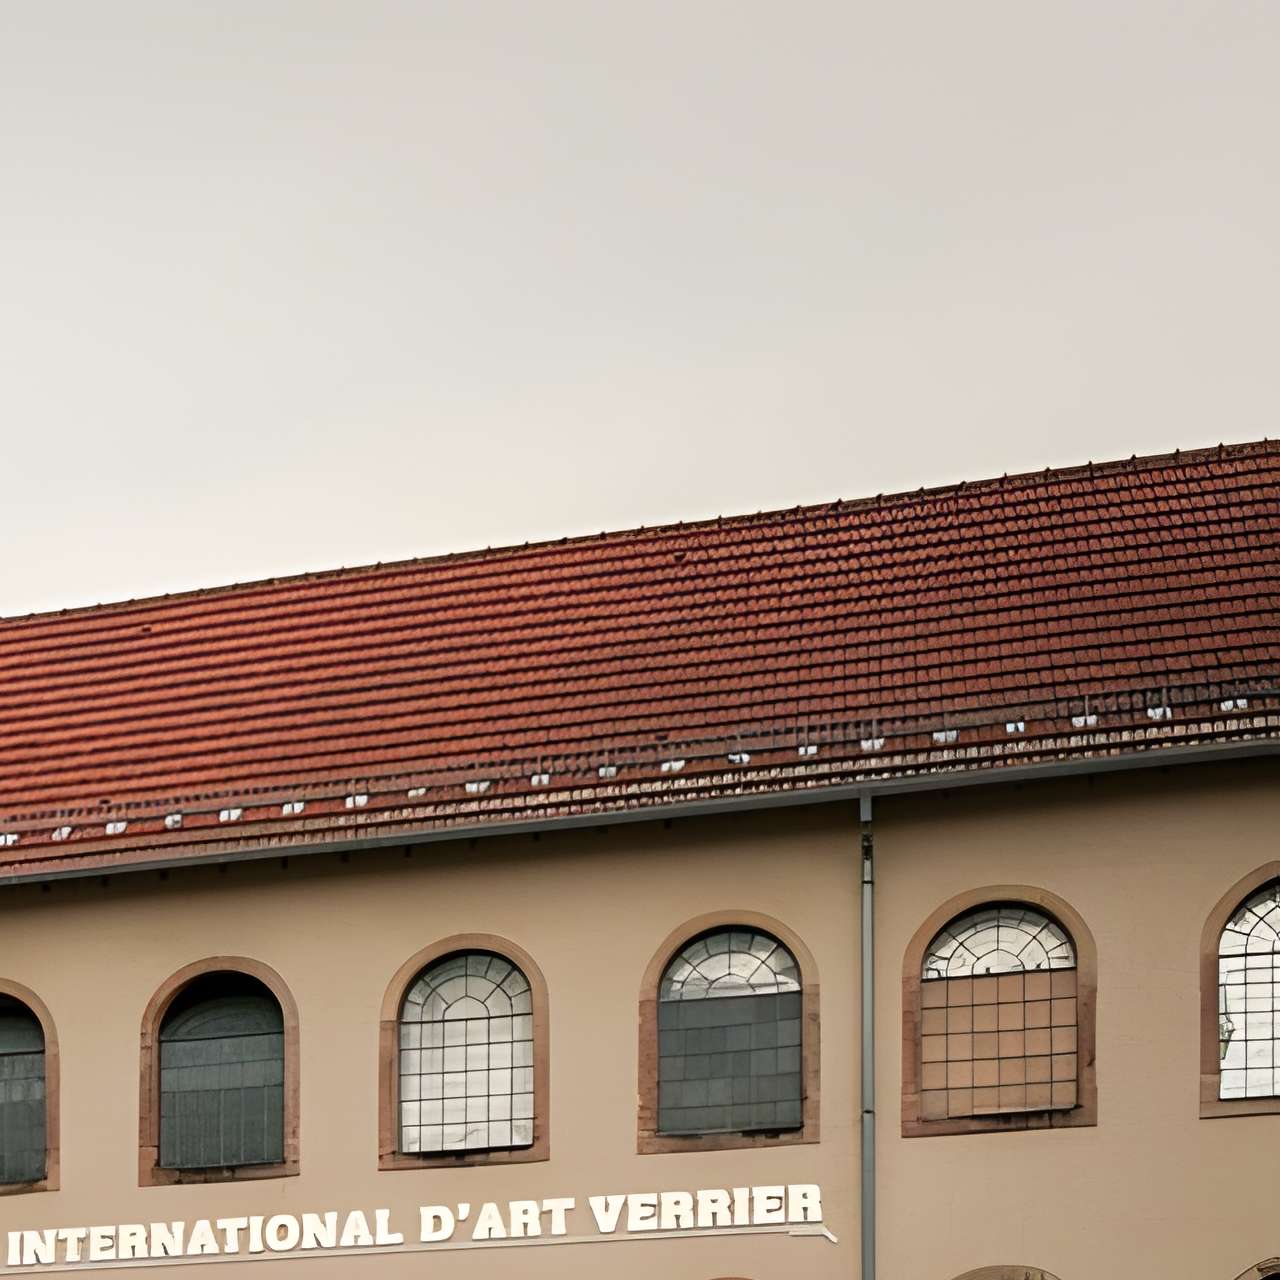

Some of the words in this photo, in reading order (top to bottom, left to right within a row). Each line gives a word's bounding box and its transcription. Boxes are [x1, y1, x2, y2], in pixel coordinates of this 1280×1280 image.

[8, 1208, 404, 1267] INTERNATIONAL
[420, 1198, 575, 1242] D'ART
[588, 1184, 823, 1234] VERRIER
